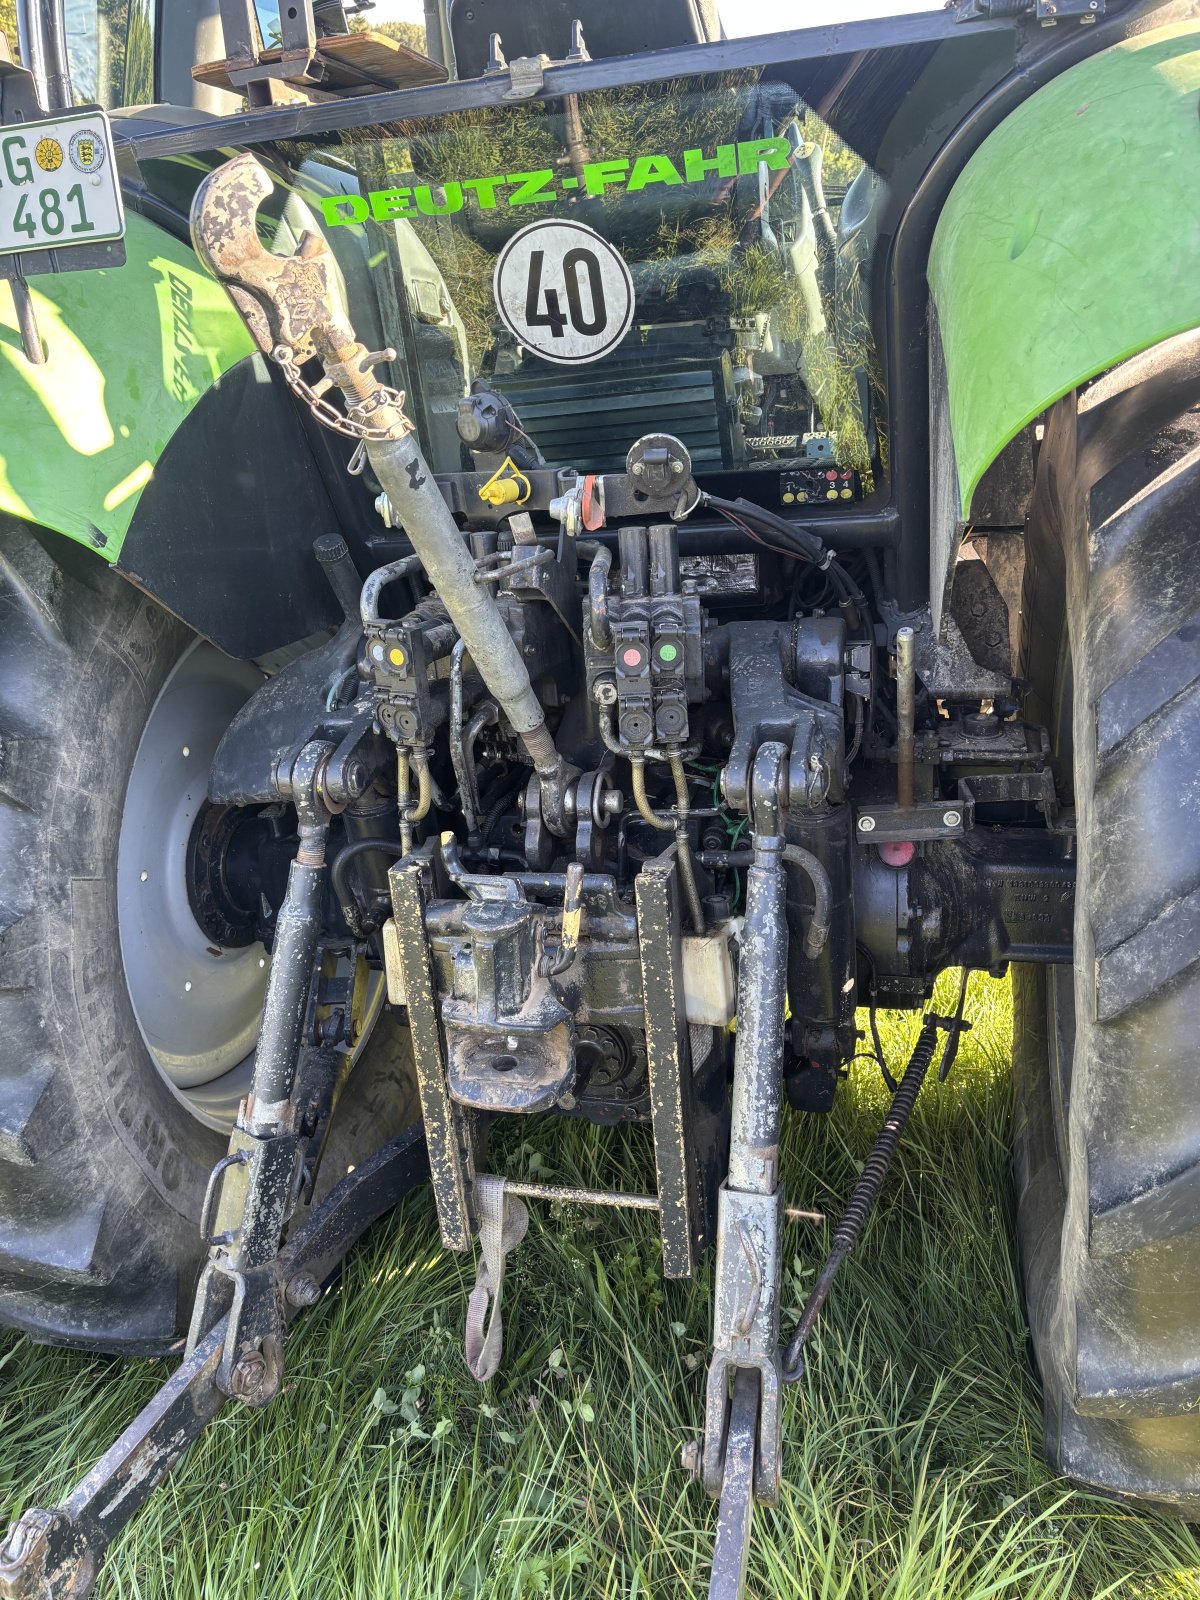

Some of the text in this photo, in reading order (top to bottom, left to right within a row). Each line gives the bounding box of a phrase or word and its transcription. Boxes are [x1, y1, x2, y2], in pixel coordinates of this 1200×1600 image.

[0, 135, 35, 188] G
[320, 137, 793, 227] DEUTZ-FAHR
[13, 183, 95, 239] 481
[525, 246, 608, 338] 40
[829, 481, 836, 489] 3
[842, 480, 849, 488] 4
